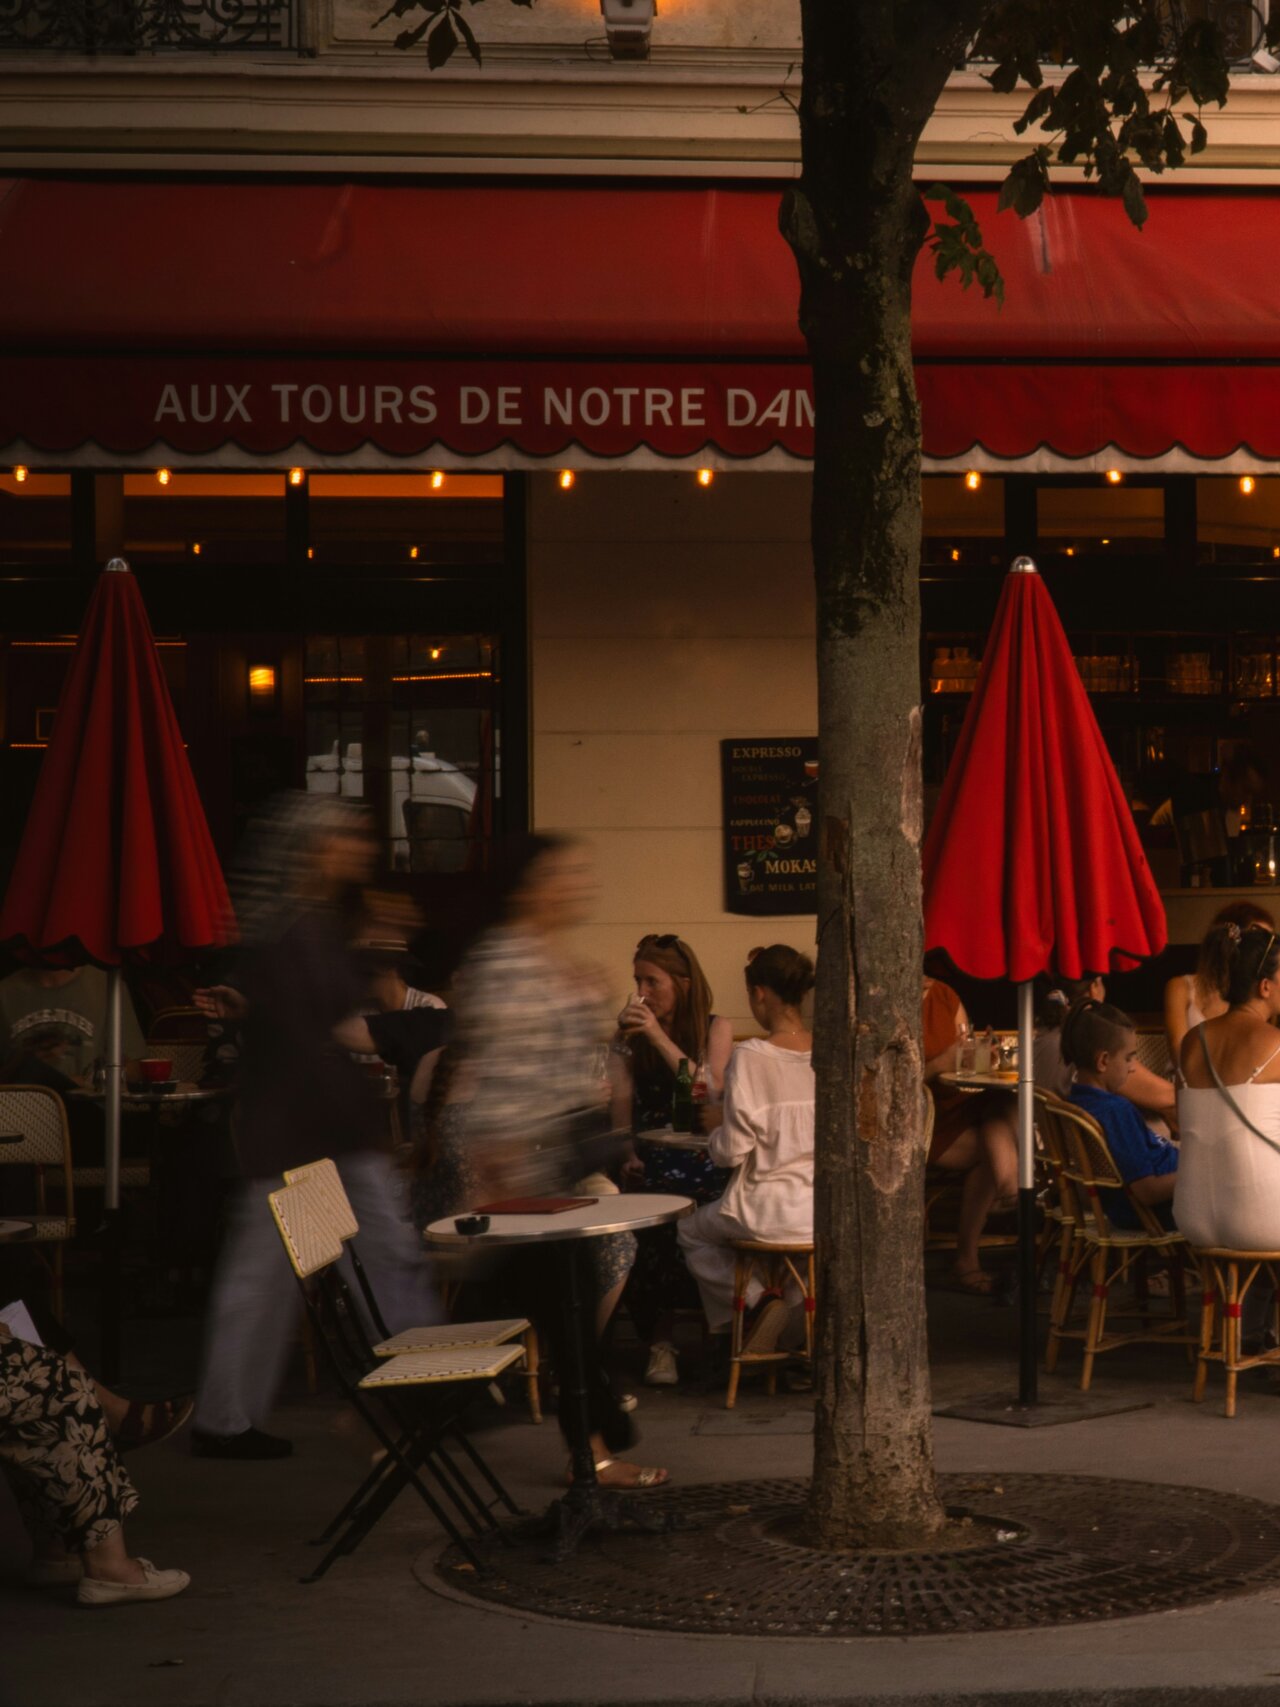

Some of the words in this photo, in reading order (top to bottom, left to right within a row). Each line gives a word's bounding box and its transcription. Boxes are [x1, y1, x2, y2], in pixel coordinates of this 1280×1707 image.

[155, 384, 252, 422] AUX
[271, 384, 438, 424] TOURS
[460, 386, 523, 425] DE
[545, 388, 706, 426] NOTRE
[727, 391, 815, 427] DAM
[732, 747, 802, 759] EXPRESSO
[768, 883, 795, 892] MILK
